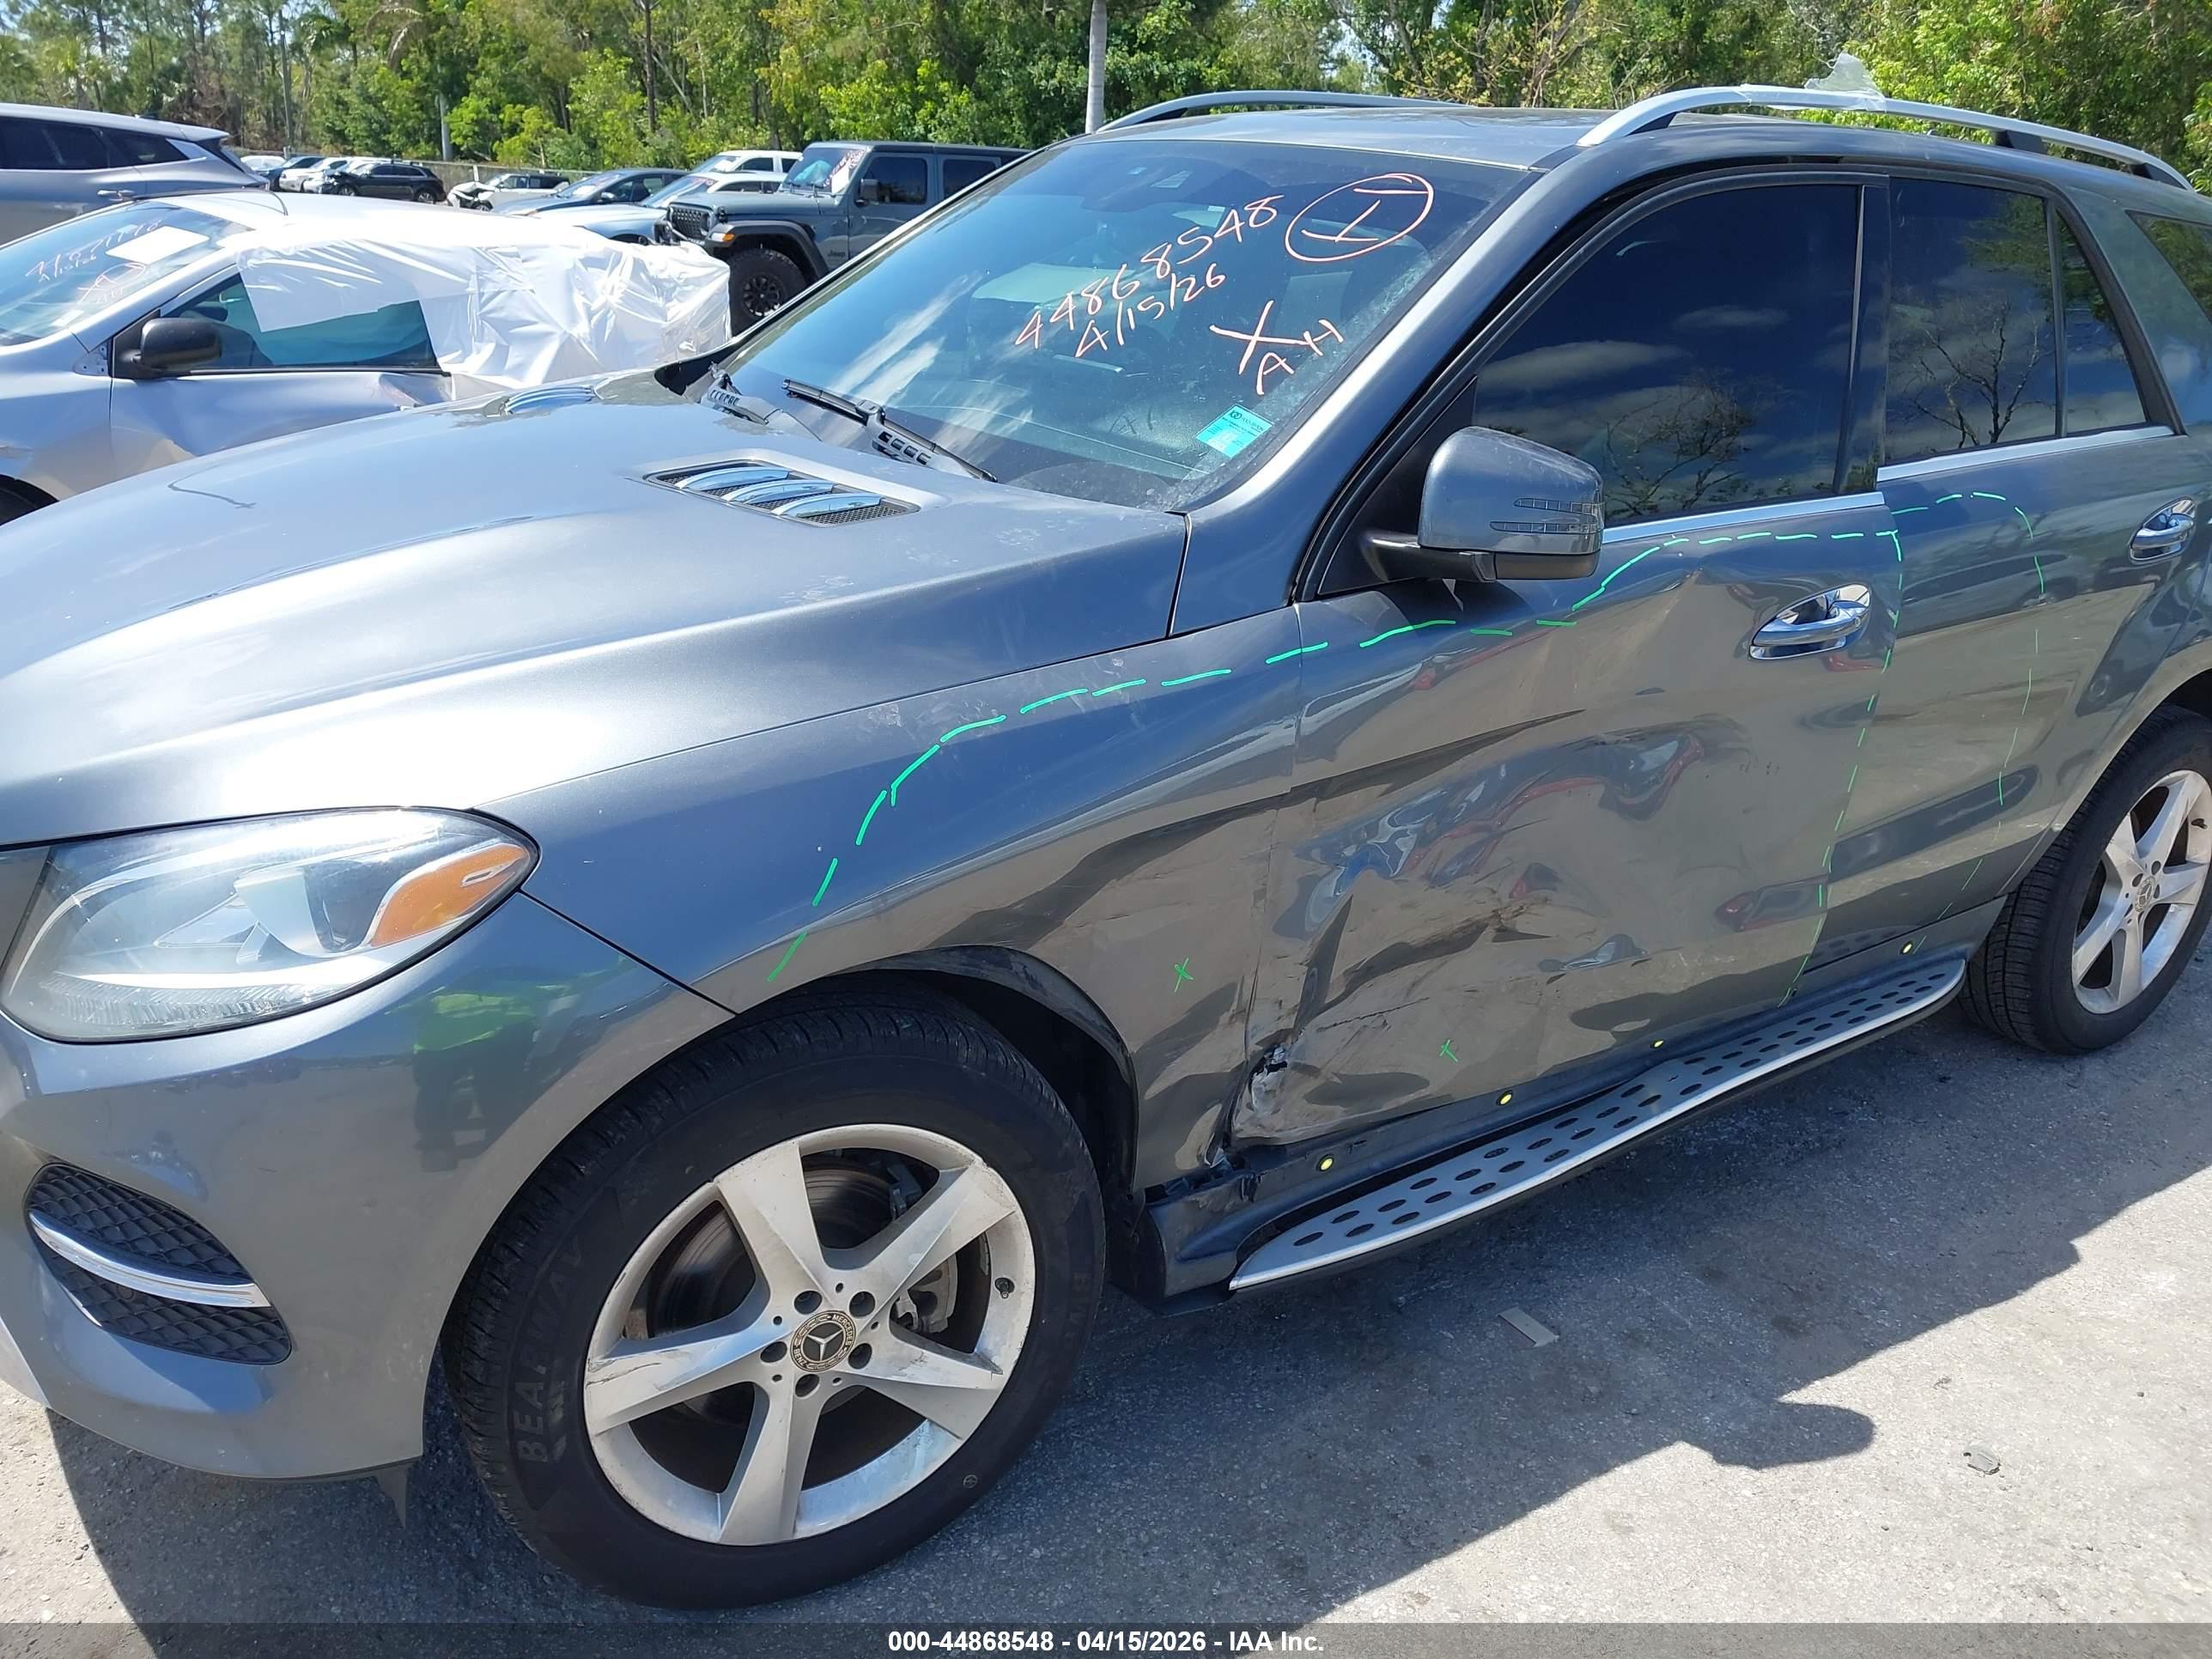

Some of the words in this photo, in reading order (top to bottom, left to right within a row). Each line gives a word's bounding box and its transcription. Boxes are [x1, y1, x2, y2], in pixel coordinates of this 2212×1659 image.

[1015, 194, 1285, 349] 44868548
[1074, 262, 1227, 358] 4/15/26
[793, 1348, 808, 1367] BENZ
[831, 1314, 854, 1346] MERCEDES
